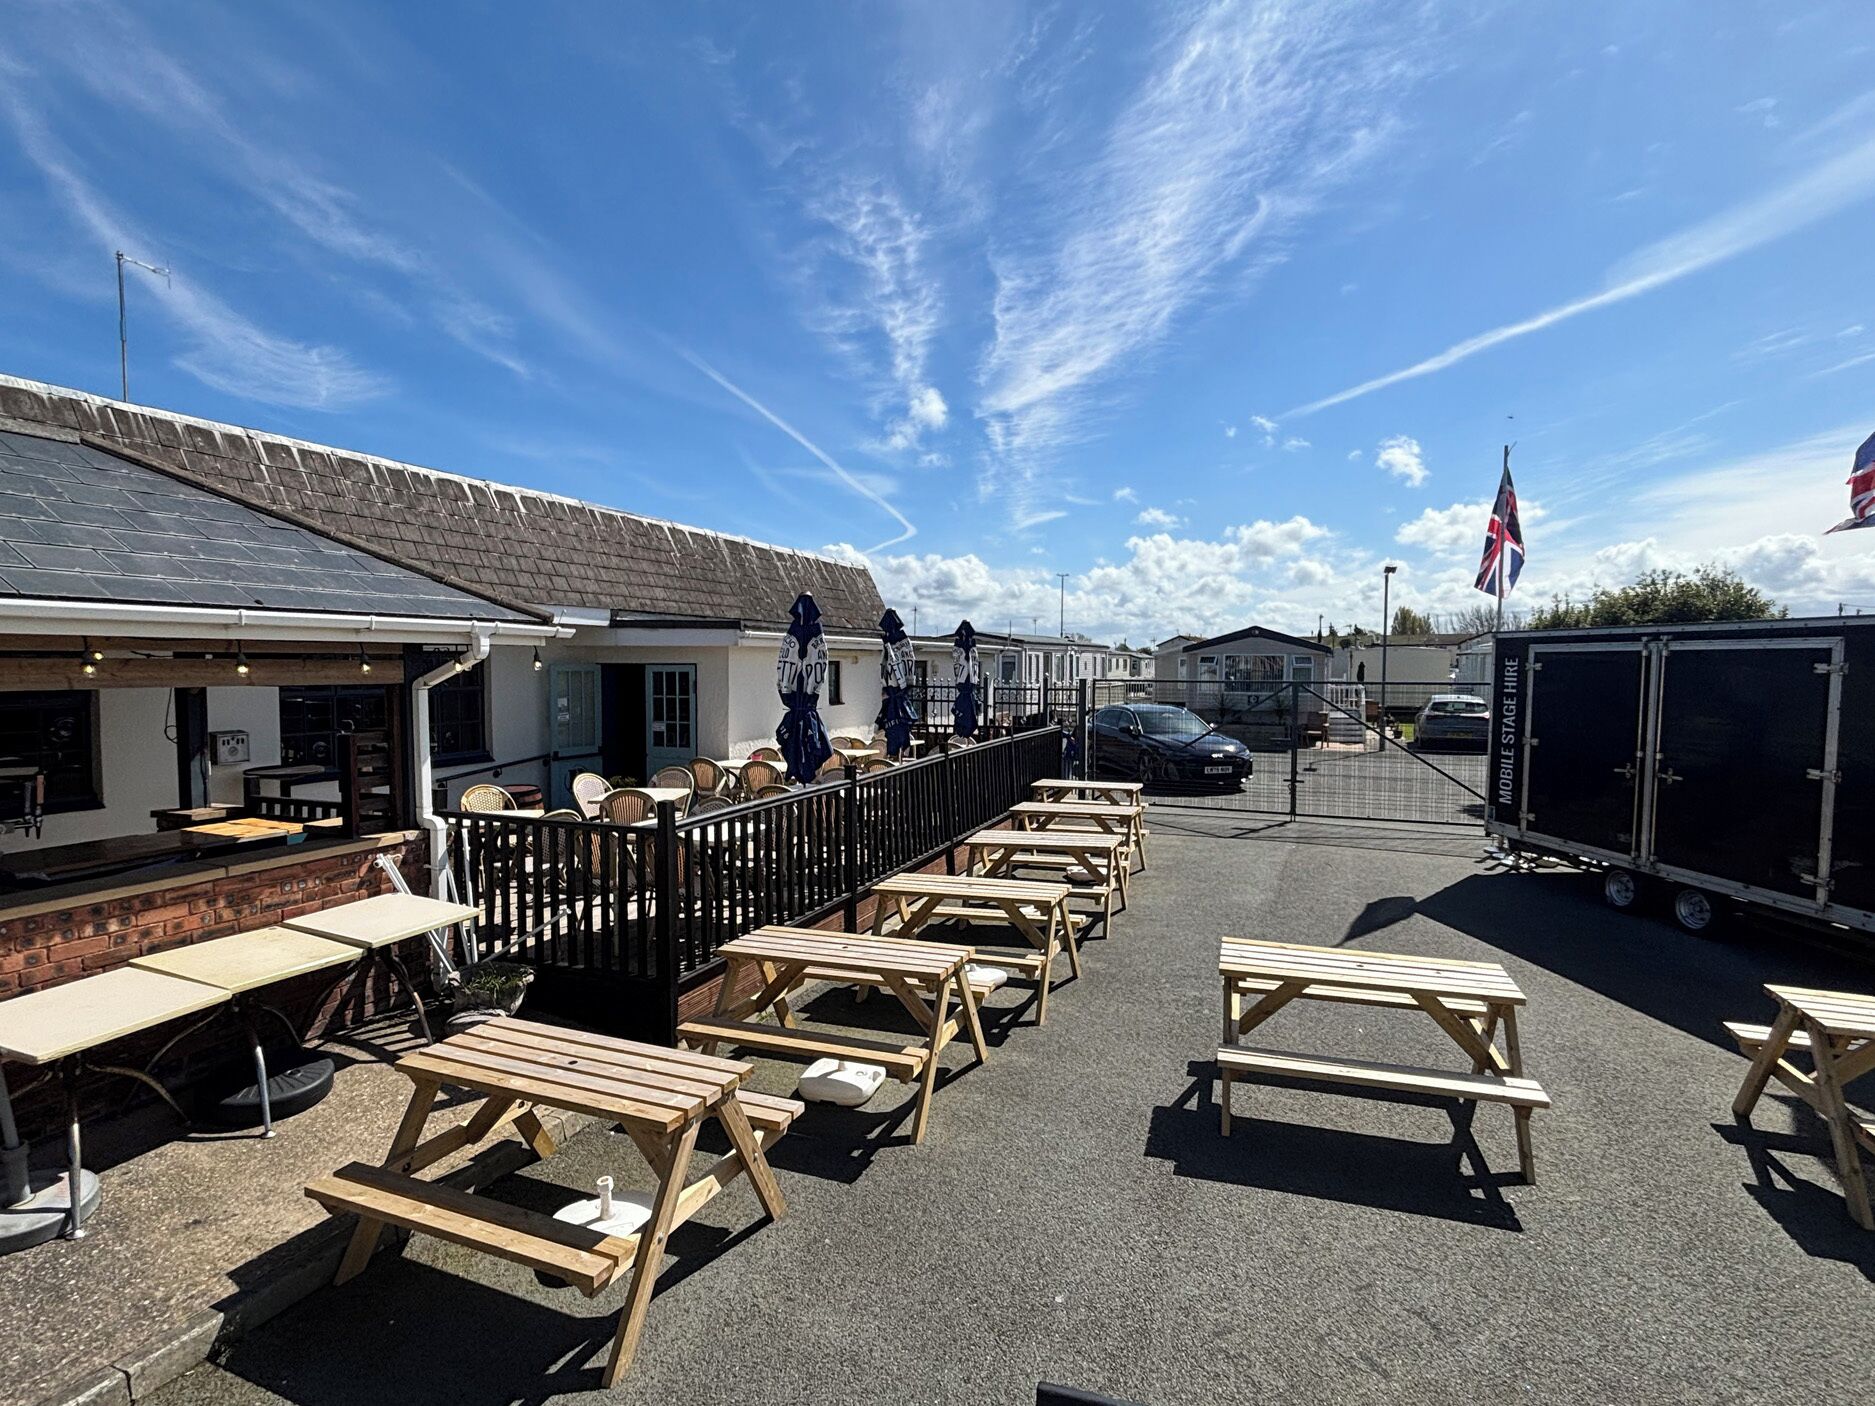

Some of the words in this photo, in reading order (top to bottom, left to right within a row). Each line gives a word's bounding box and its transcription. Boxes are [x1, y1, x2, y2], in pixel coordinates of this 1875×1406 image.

[1504, 658, 1519, 693] HIRE
[1502, 696, 1517, 744] STAGE
[1499, 747, 1514, 804] MOBILE
